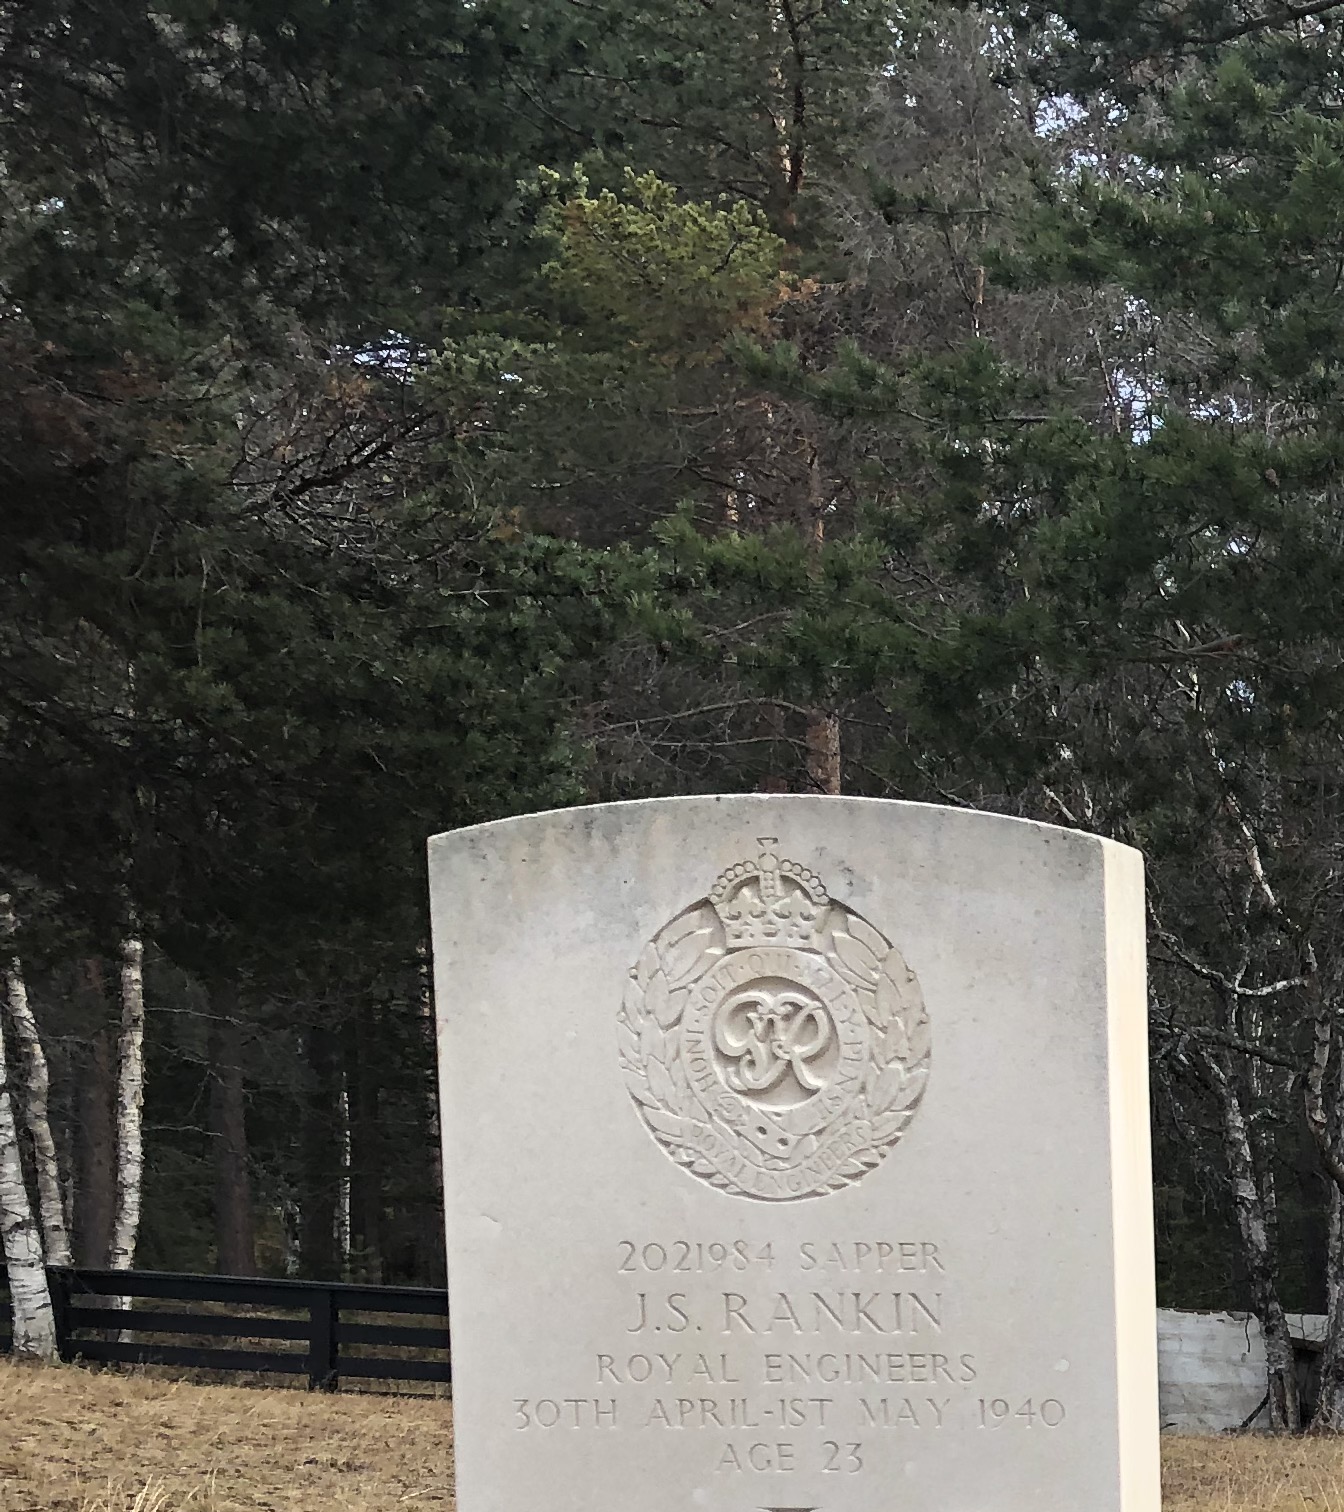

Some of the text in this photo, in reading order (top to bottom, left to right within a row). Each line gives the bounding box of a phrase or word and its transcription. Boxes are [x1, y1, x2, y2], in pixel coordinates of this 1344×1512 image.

[617, 1240, 947, 1274] 2021984 SAPPER
[626, 1292, 944, 1335] J.S. RANKIN
[595, 1353, 977, 1384] ROYAL ENGINEERS
[512, 1398, 618, 1430] 30TH
[858, 1398, 951, 1429] MAY
[977, 1398, 1066, 1429] 1940
[715, 1440, 865, 1474] AGE 23
